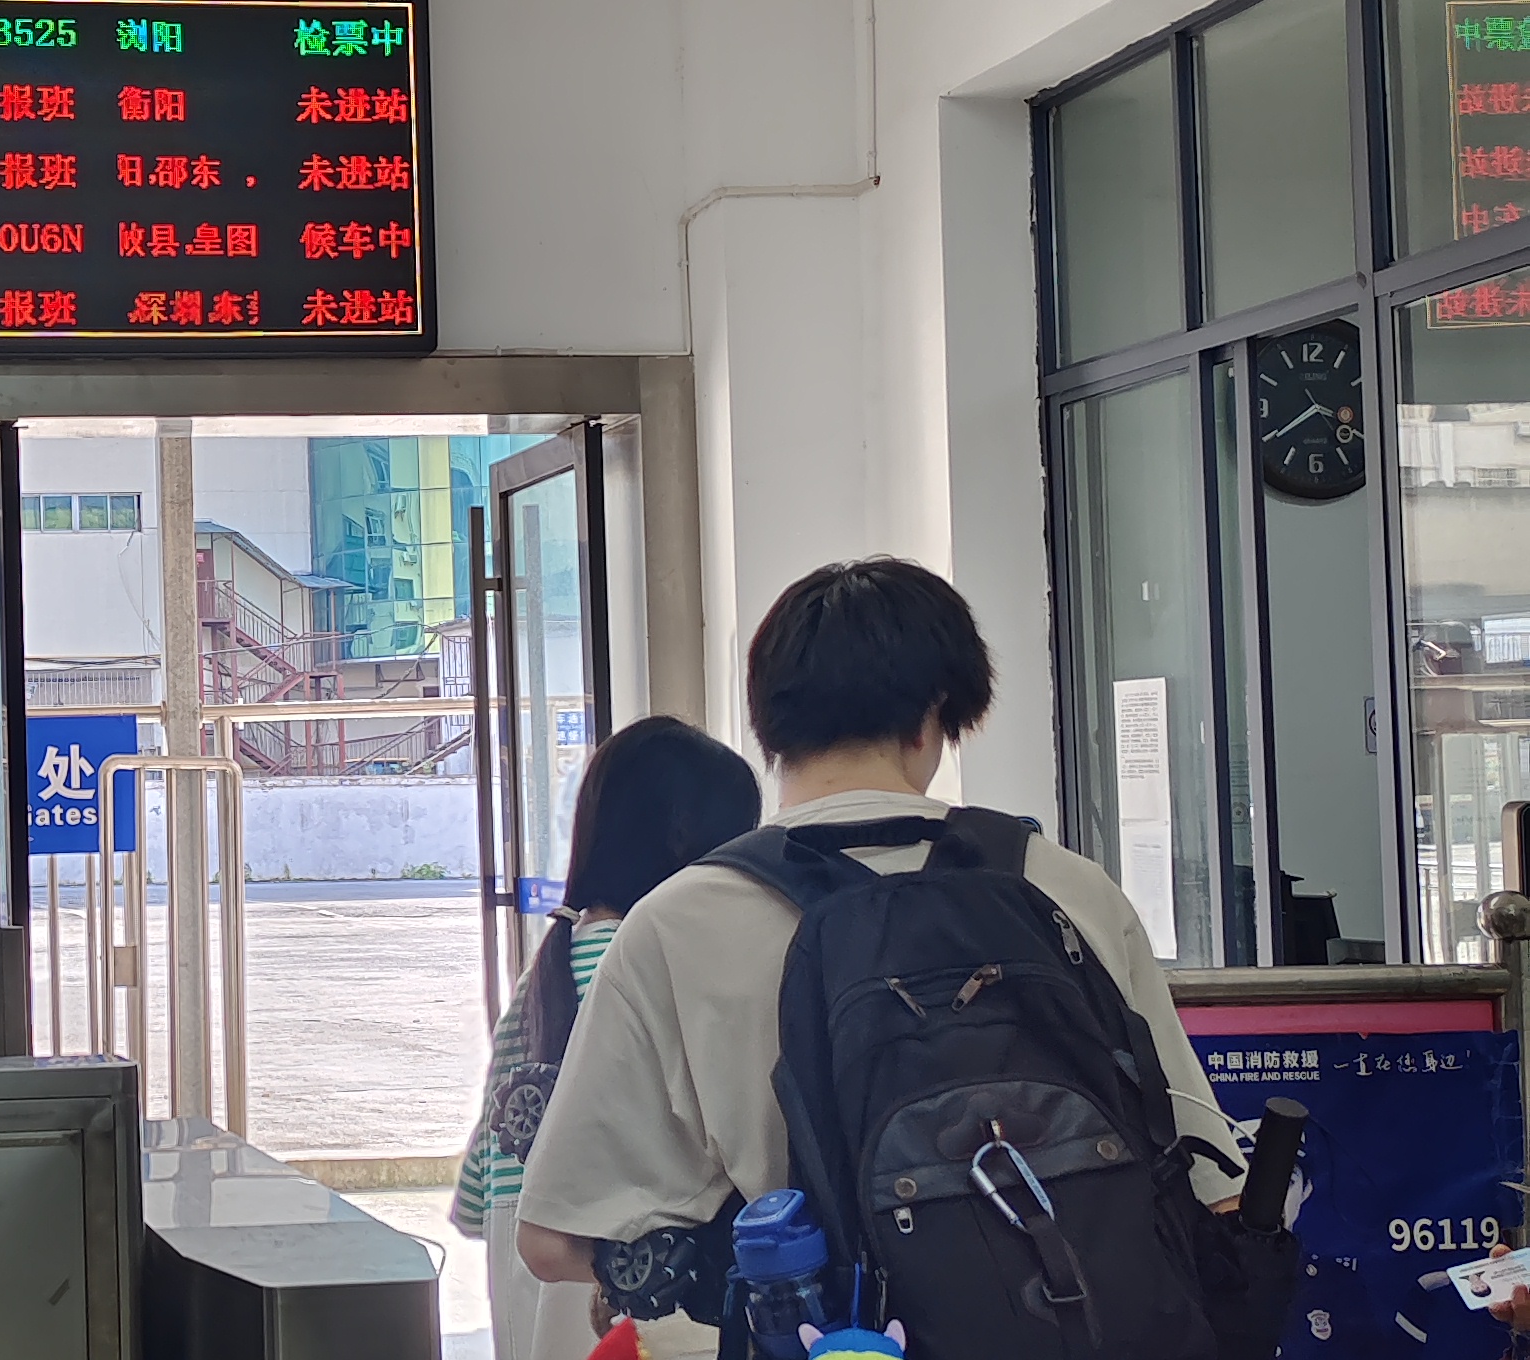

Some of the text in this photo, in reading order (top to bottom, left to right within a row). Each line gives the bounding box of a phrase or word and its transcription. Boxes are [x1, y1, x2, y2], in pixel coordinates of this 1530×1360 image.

[116, 19, 182, 52] 浏阳
[294, 19, 403, 56] 检票中
[118, 86, 186, 121] 衡阳
[296, 86, 408, 123] 未进站
[298, 154, 410, 191] 未进站
[300, 221, 411, 259] 候车中
[302, 289, 413, 325] 未进站
[1303, 343, 1324, 363] 12
[1309, 453, 1324, 474] 6
[37, 743, 95, 801] 处
[28, 803, 98, 827] ates
[1207, 1050, 1319, 1070] 中国消防救援
[1209, 1071, 1320, 1082] CHINA FIRE AND RESCUE
[1388, 1216, 1500, 1252] 96119
